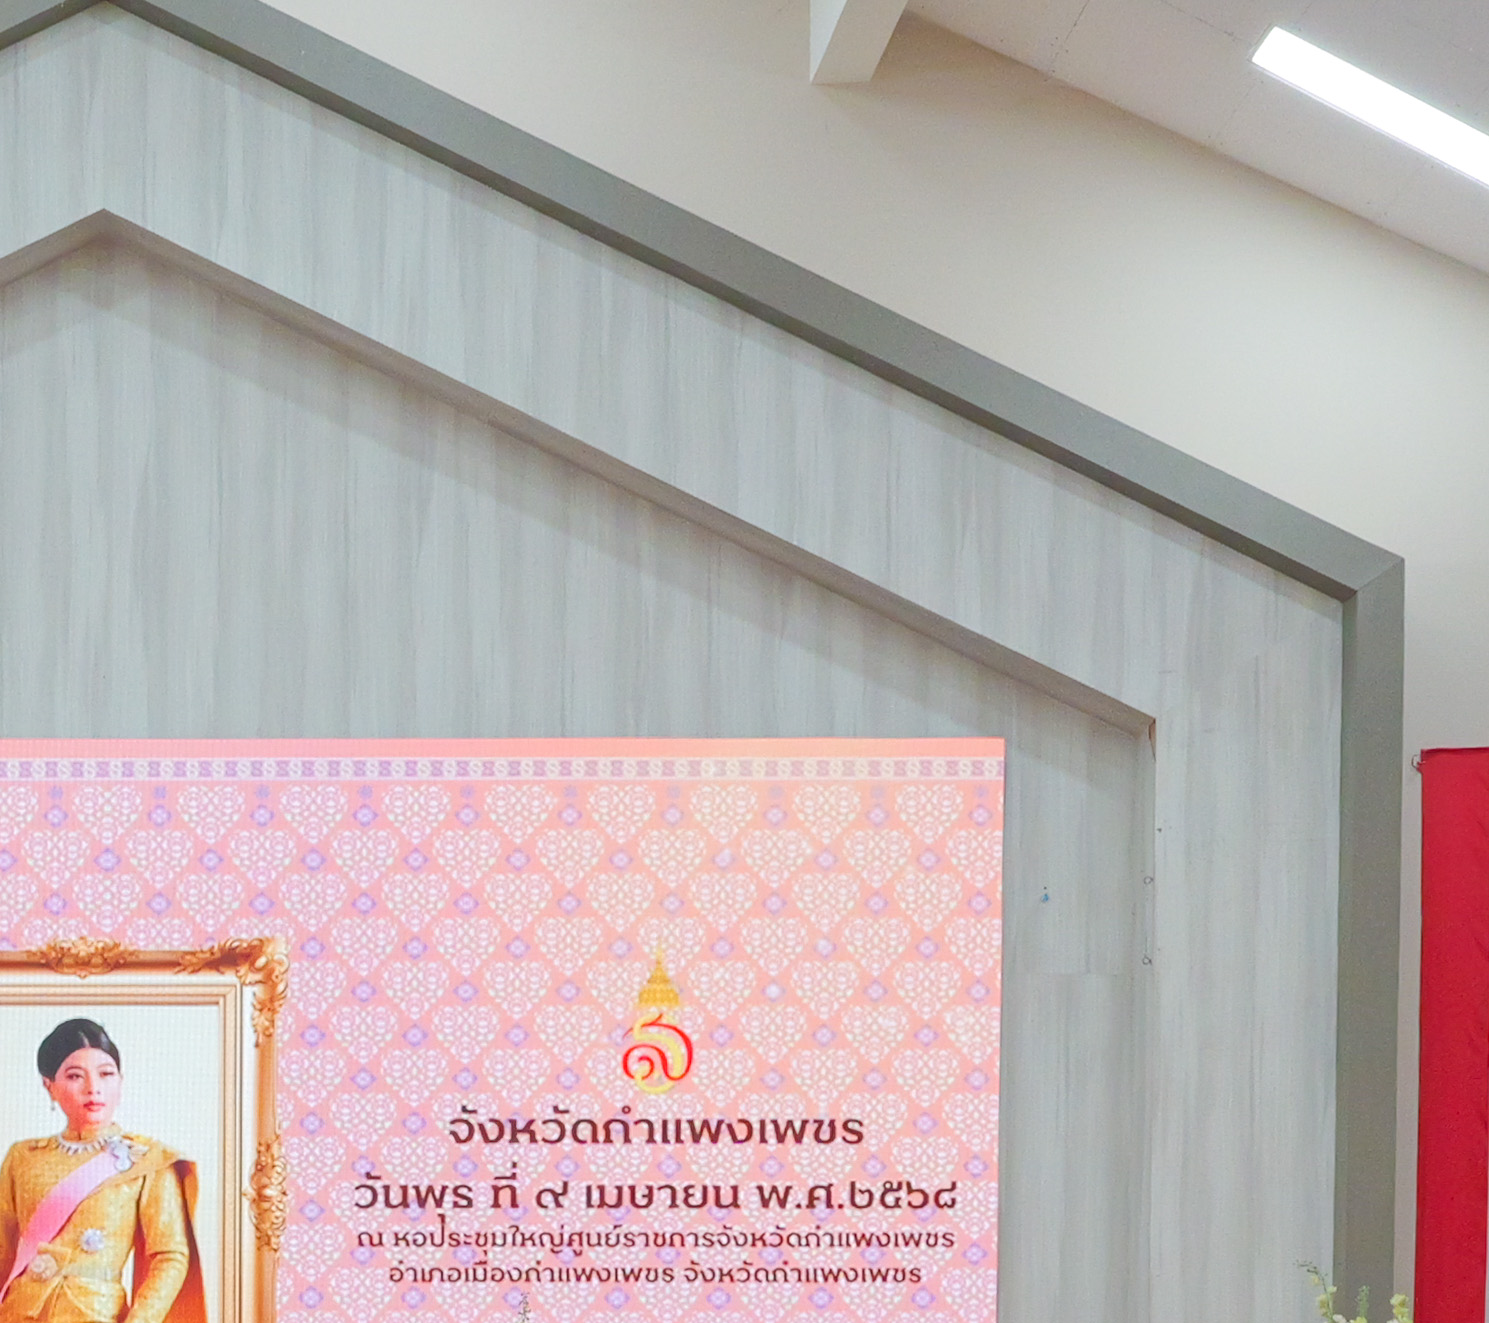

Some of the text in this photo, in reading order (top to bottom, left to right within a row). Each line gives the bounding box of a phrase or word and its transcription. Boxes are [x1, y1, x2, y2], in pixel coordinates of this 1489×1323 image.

[449, 1105, 864, 1145] จังหวัดกำแพงเพชร
[490, 1161, 520, 1209] ที่
[535, 1180, 569, 1209] ๙
[585, 1184, 741, 1210] เมษายน
[756, 1180, 957, 1210] พ.ศ.๒๕๖๘
[357, 1231, 384, 1247] ณ
[684, 1260, 922, 1284] จังหวัดกำแพงเพชร
